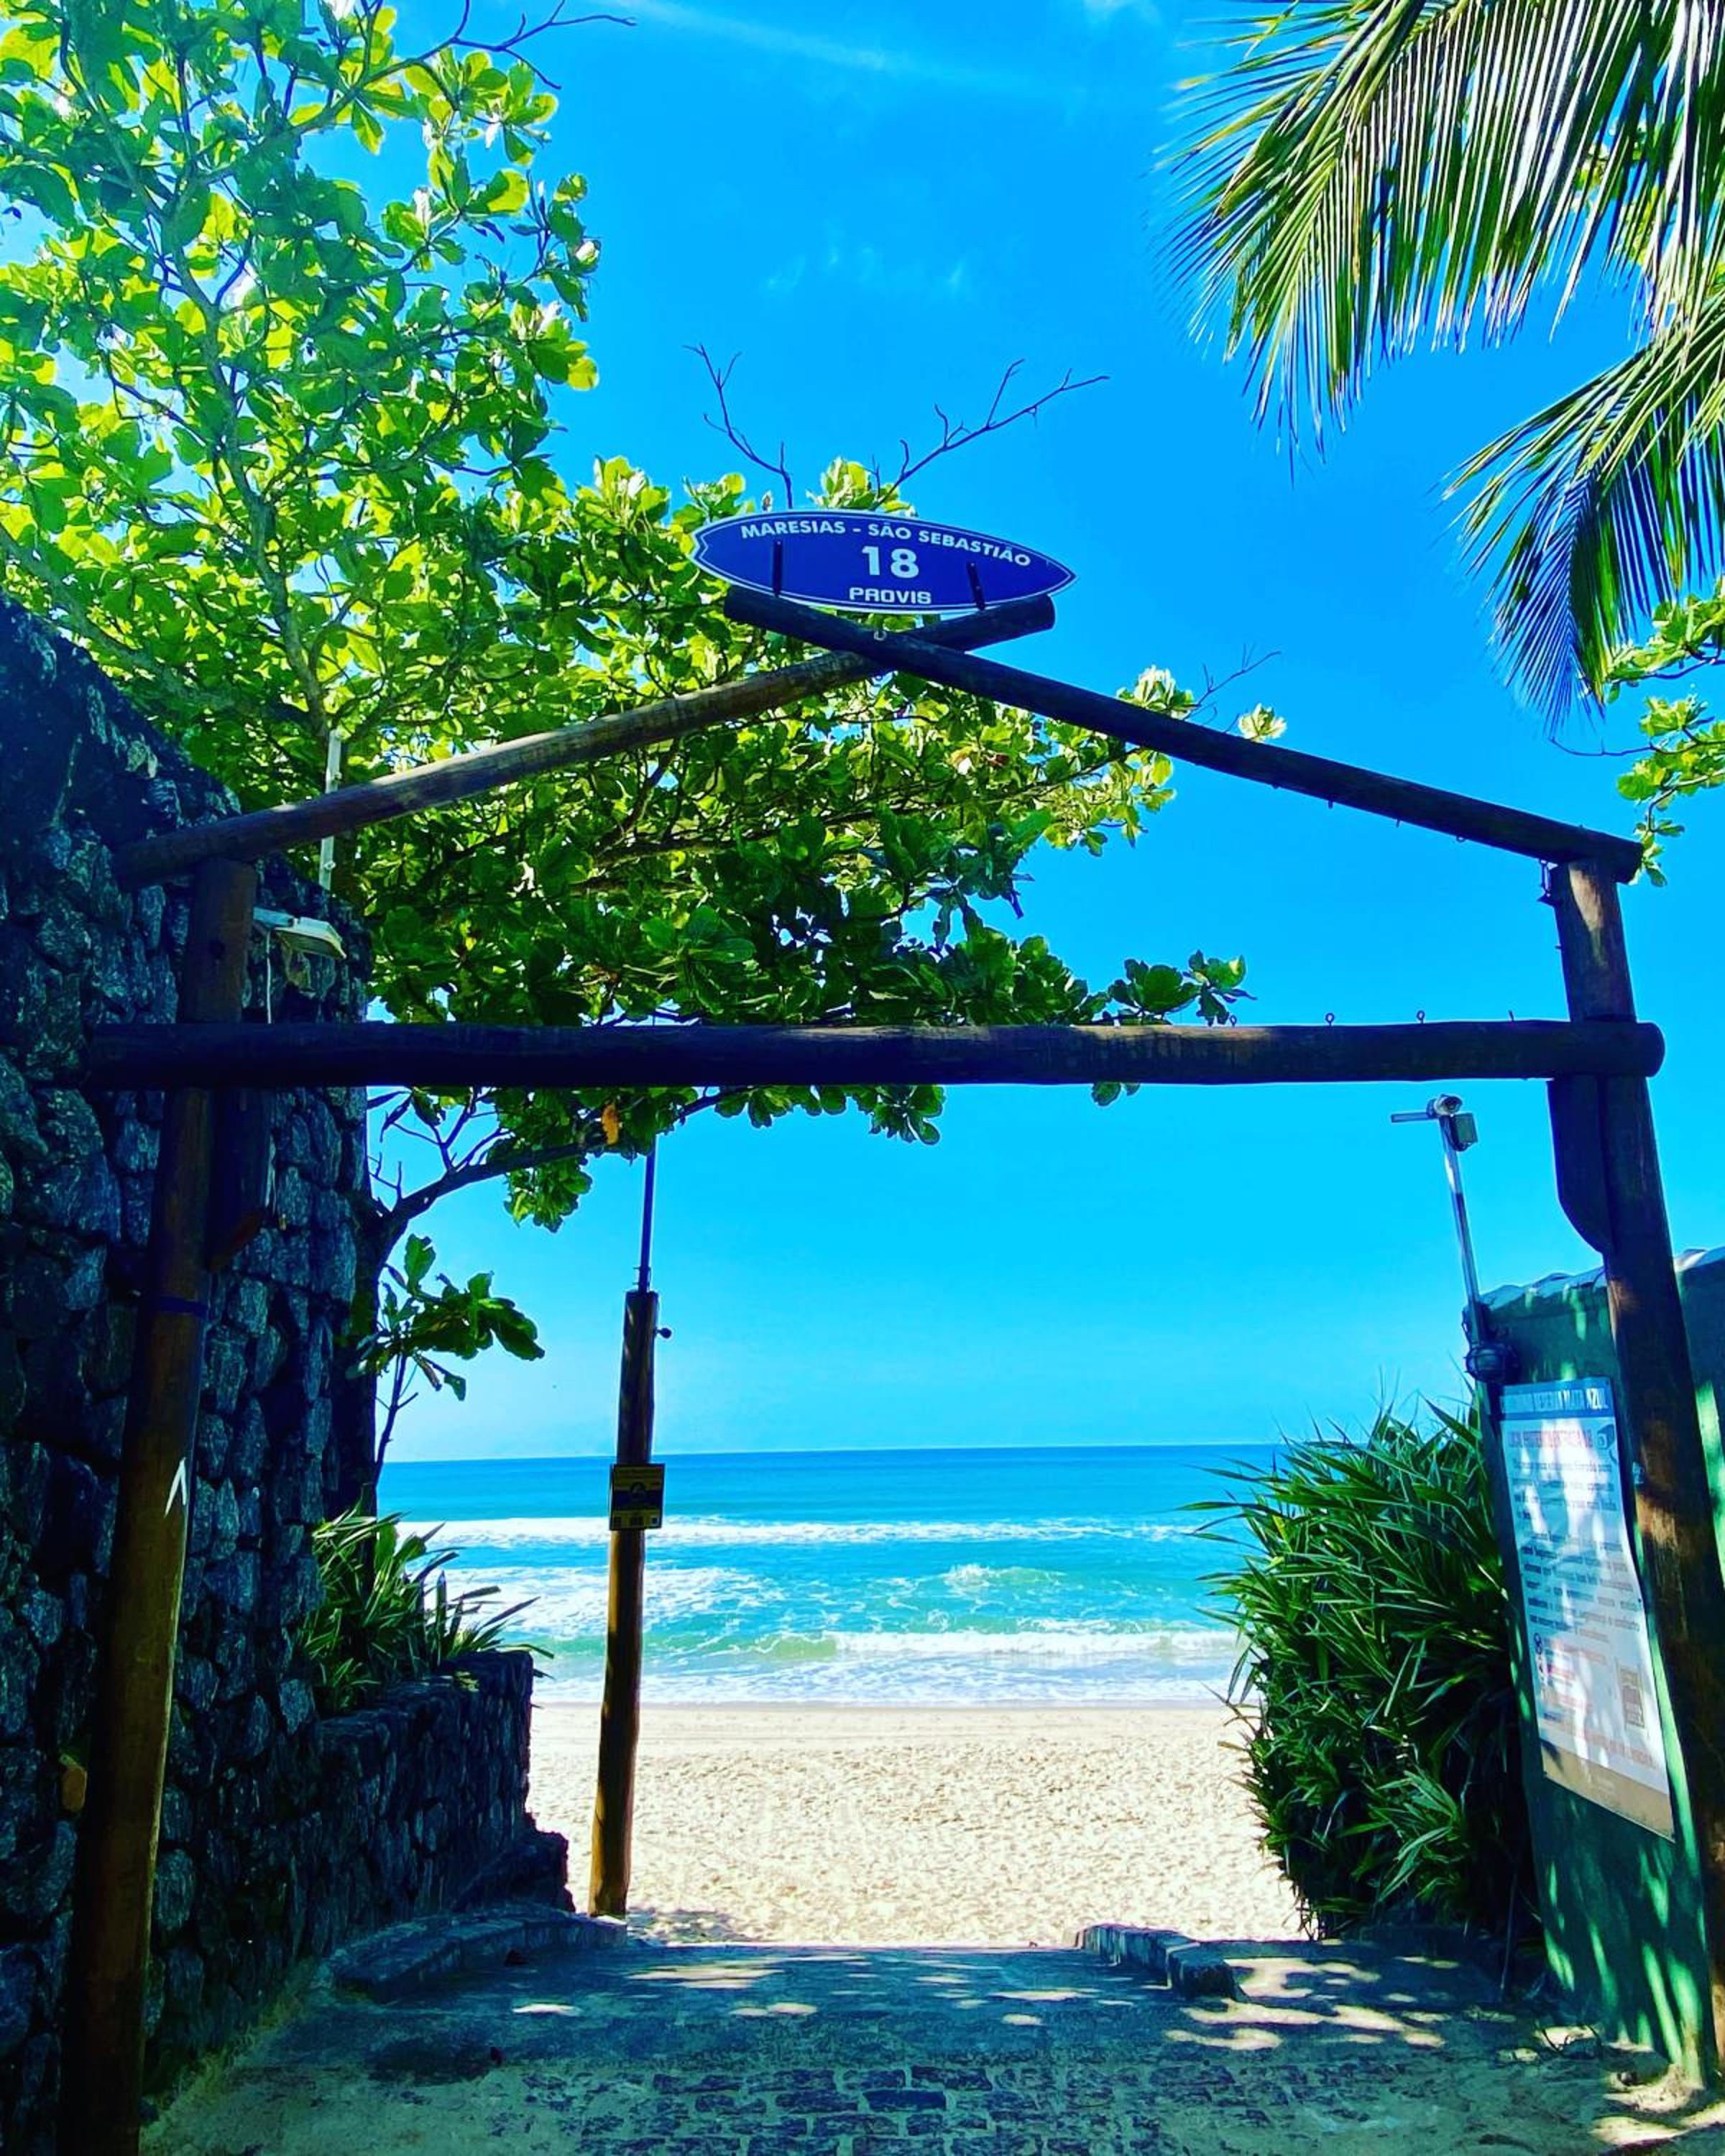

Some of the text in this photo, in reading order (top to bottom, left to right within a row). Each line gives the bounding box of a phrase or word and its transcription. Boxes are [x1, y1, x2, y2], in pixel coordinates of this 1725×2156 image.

[740, 520, 846, 538] MARESIAS
[868, 522, 911, 540] SÃO
[919, 530, 1031, 566] SEBASTIÃO
[862, 545, 919, 579] 18
[849, 586, 932, 604] PROVIS
